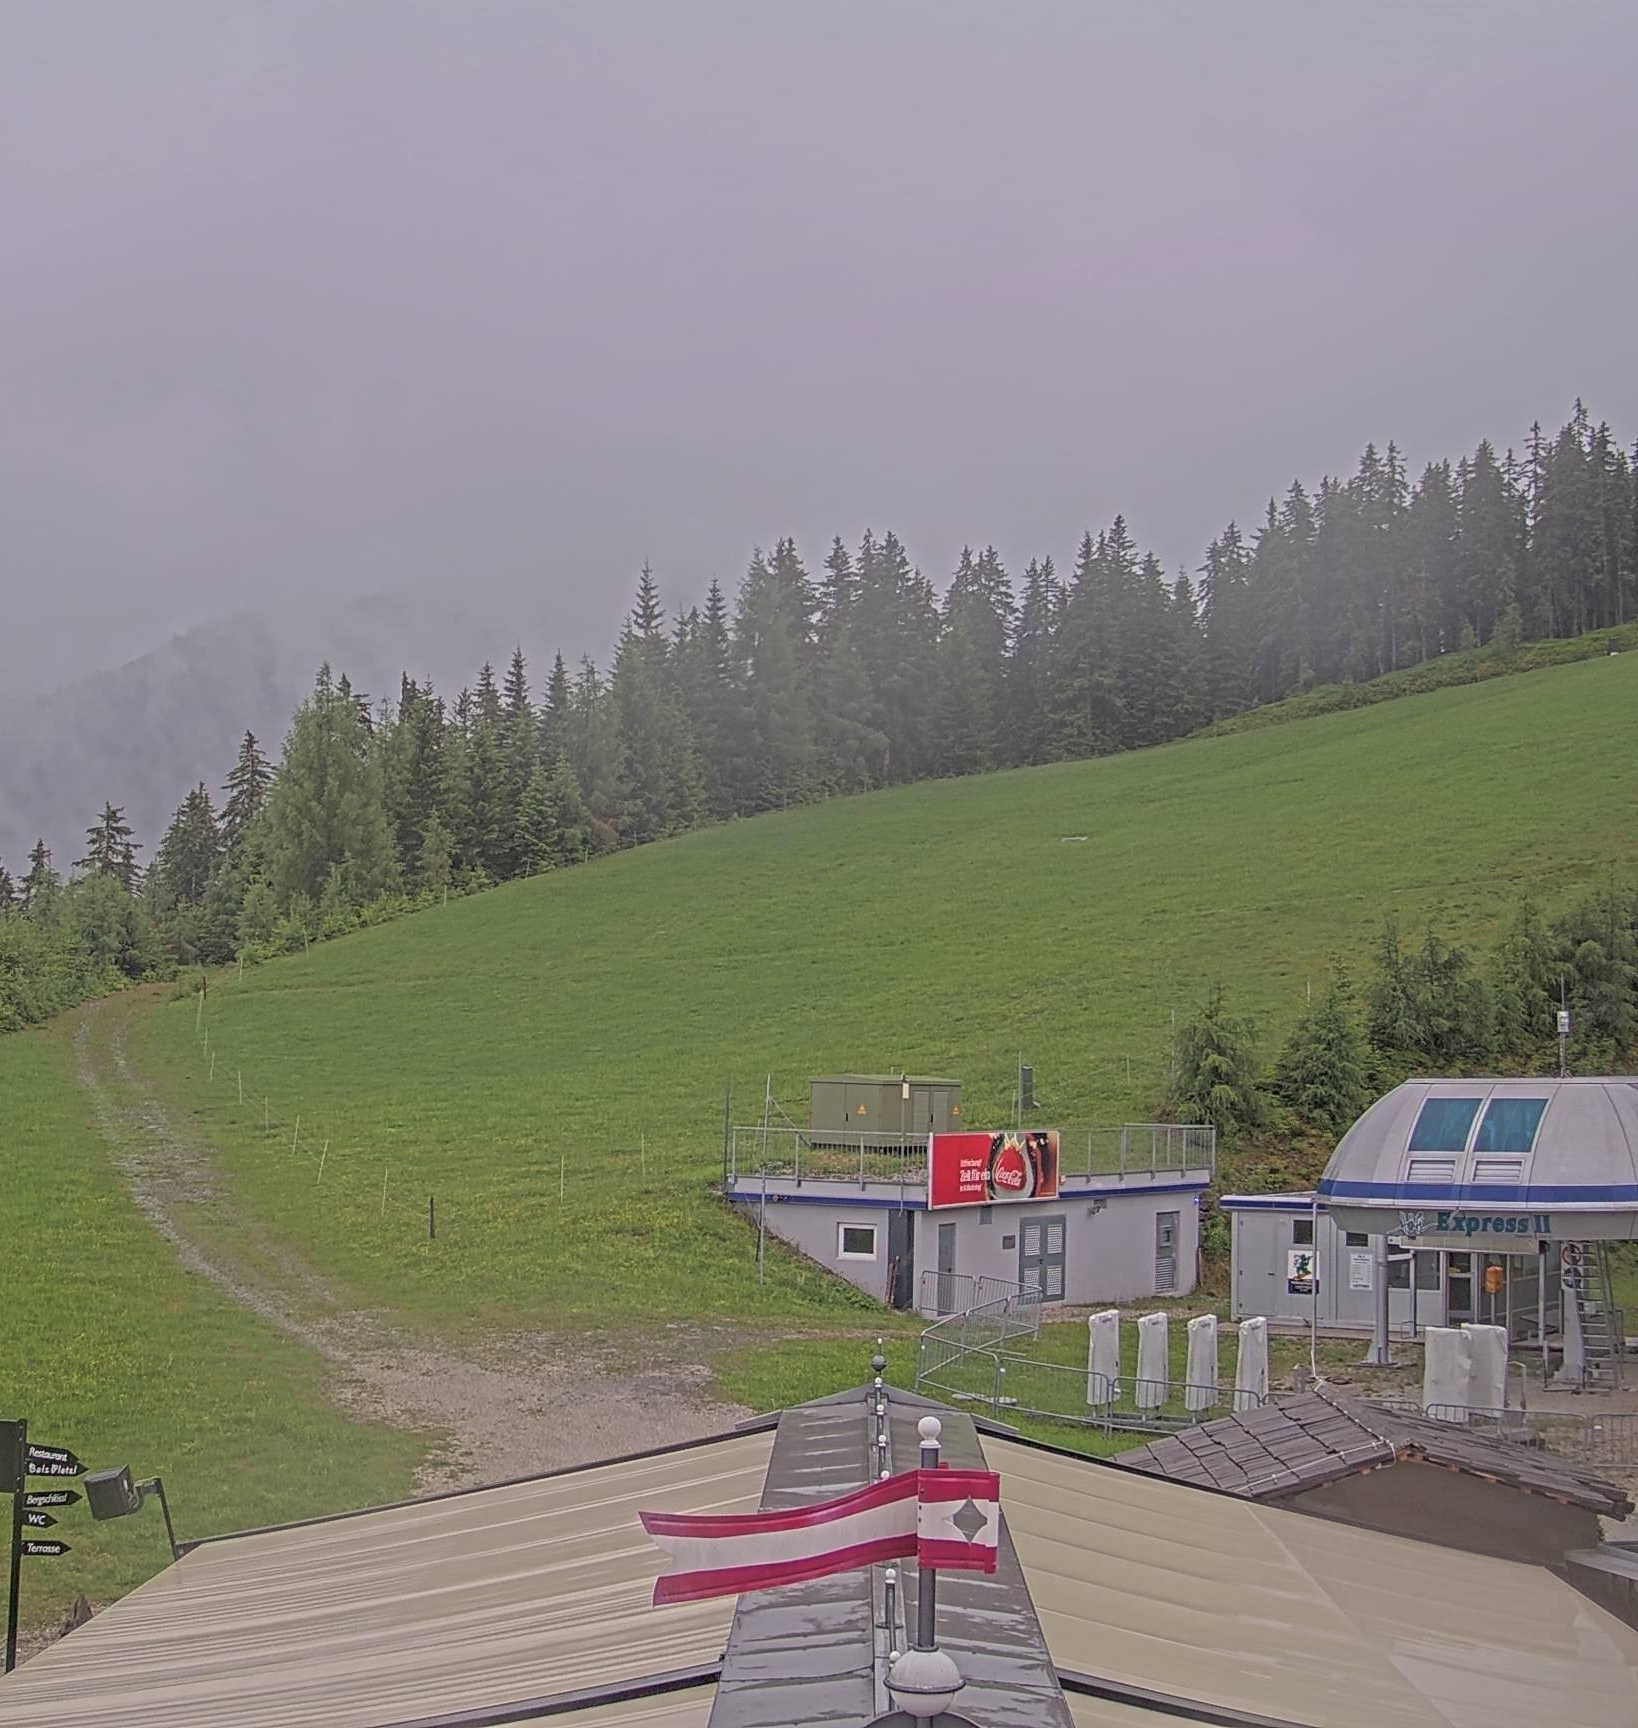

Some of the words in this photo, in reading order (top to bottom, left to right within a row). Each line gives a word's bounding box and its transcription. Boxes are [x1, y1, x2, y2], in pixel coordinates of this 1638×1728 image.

[1436, 1211, 1529, 1237] Express
[29, 1446, 68, 1462] Restaurant
[28, 1513, 46, 1525] WC
[27, 1543, 61, 1553] Terrasse
